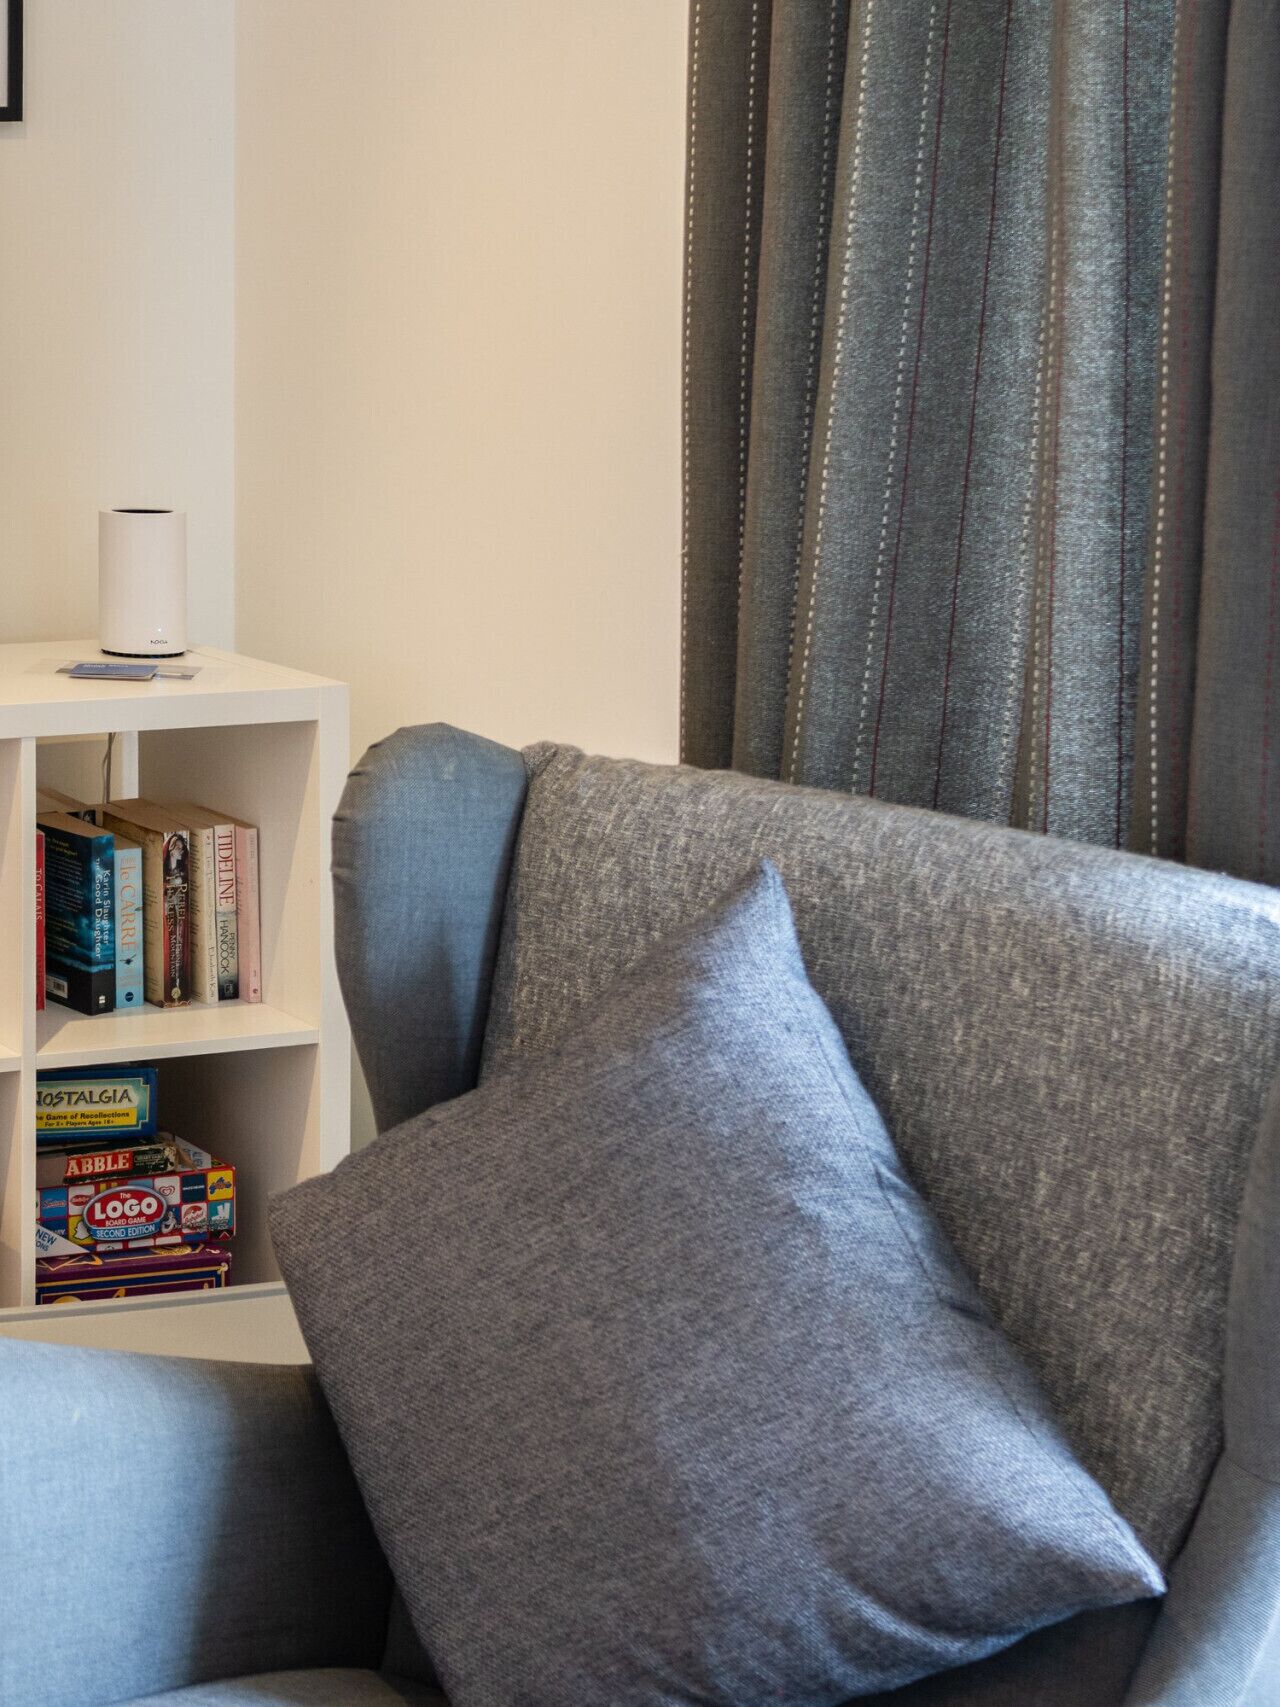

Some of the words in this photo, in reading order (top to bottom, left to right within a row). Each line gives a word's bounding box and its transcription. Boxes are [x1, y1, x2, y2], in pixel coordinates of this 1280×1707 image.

[120, 866, 137, 881] le
[217, 830, 235, 907] TIDELINE
[94, 874, 103, 905] Good
[102, 868, 111, 897] Karin
[177, 882, 188, 921] REBEL
[94, 908, 103, 960] Daughter
[101, 898, 111, 946] Slaughter
[219, 919, 230, 975] HANCOCK
[228, 932, 236, 960] PENNY
[46, 1113, 68, 1121] Game
[80, 1111, 130, 1120] Recollections
[65, 1120, 87, 1128] Players
[65, 1152, 131, 1178] ABBLE
[94, 1196, 158, 1220] LOGO
[120, 1192, 131, 1200] The
[96, 1226, 127, 1239] SECOND
[128, 1223, 156, 1237] EDITION
[105, 1217, 127, 1227] BOARD
[127, 1216, 147, 1226] GAME
[35, 1228, 58, 1246] NEW
